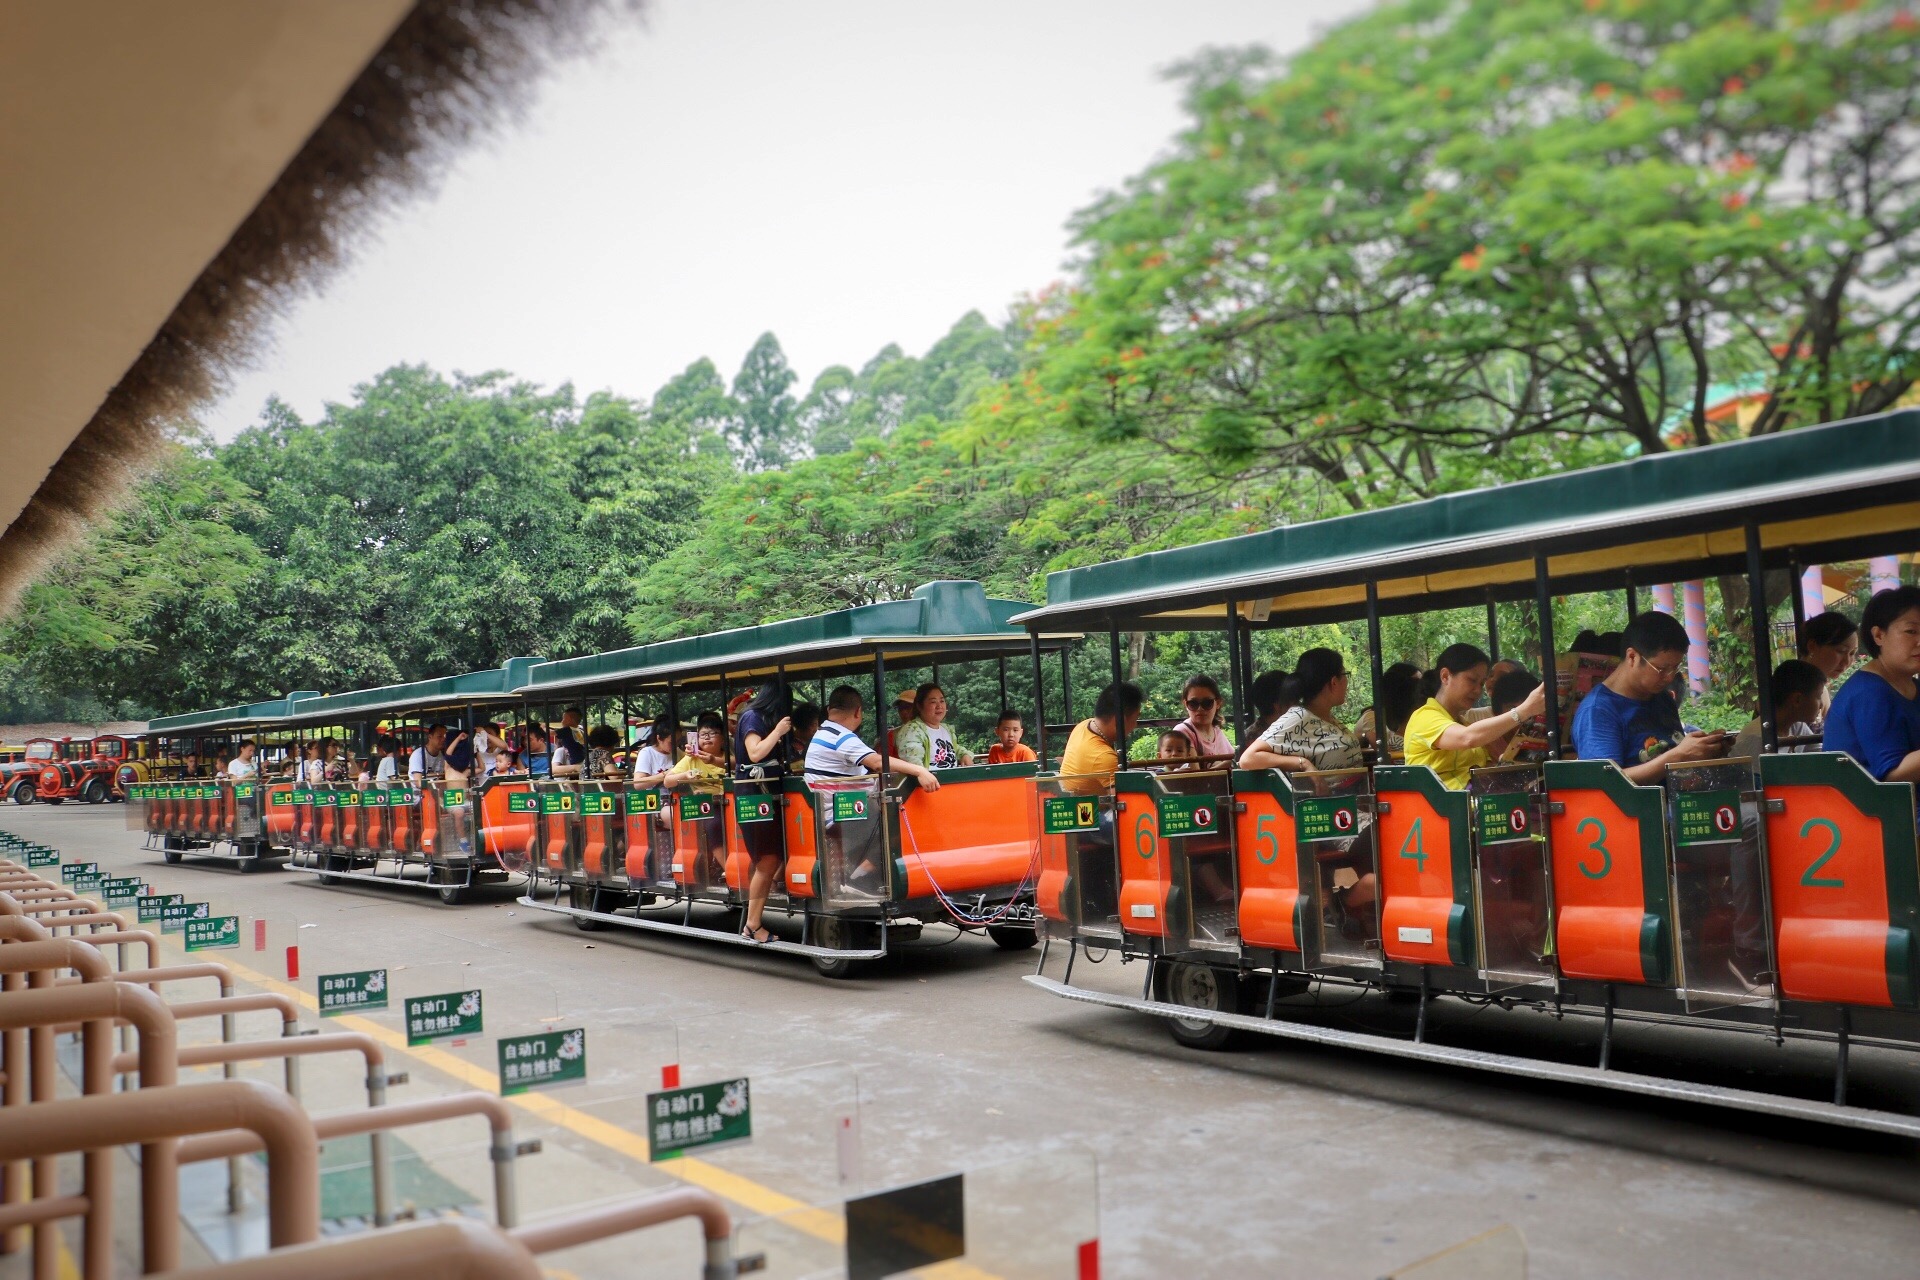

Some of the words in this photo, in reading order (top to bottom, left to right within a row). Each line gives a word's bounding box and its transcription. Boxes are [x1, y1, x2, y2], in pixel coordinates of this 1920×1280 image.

[1135, 812, 1156, 860] 6
[1255, 814, 1279, 866] 5
[1400, 817, 1429, 873] 4
[1576, 817, 1613, 881] 3
[1798, 818, 1845, 889] 2
[188, 922, 215, 933] 自动门
[188, 931, 224, 943] 请勿推拉
[323, 977, 356, 991] 自动门
[323, 990, 369, 1006] 请勿推拉
[411, 999, 448, 1015] 自动门
[411, 1014, 461, 1032] 请勿推拉
[504, 1040, 547, 1061] 自动门
[504, 1056, 563, 1079] 请勿推拉
[655, 1092, 705, 1118] 自动门
[654, 1112, 724, 1142] 请勿推拉
